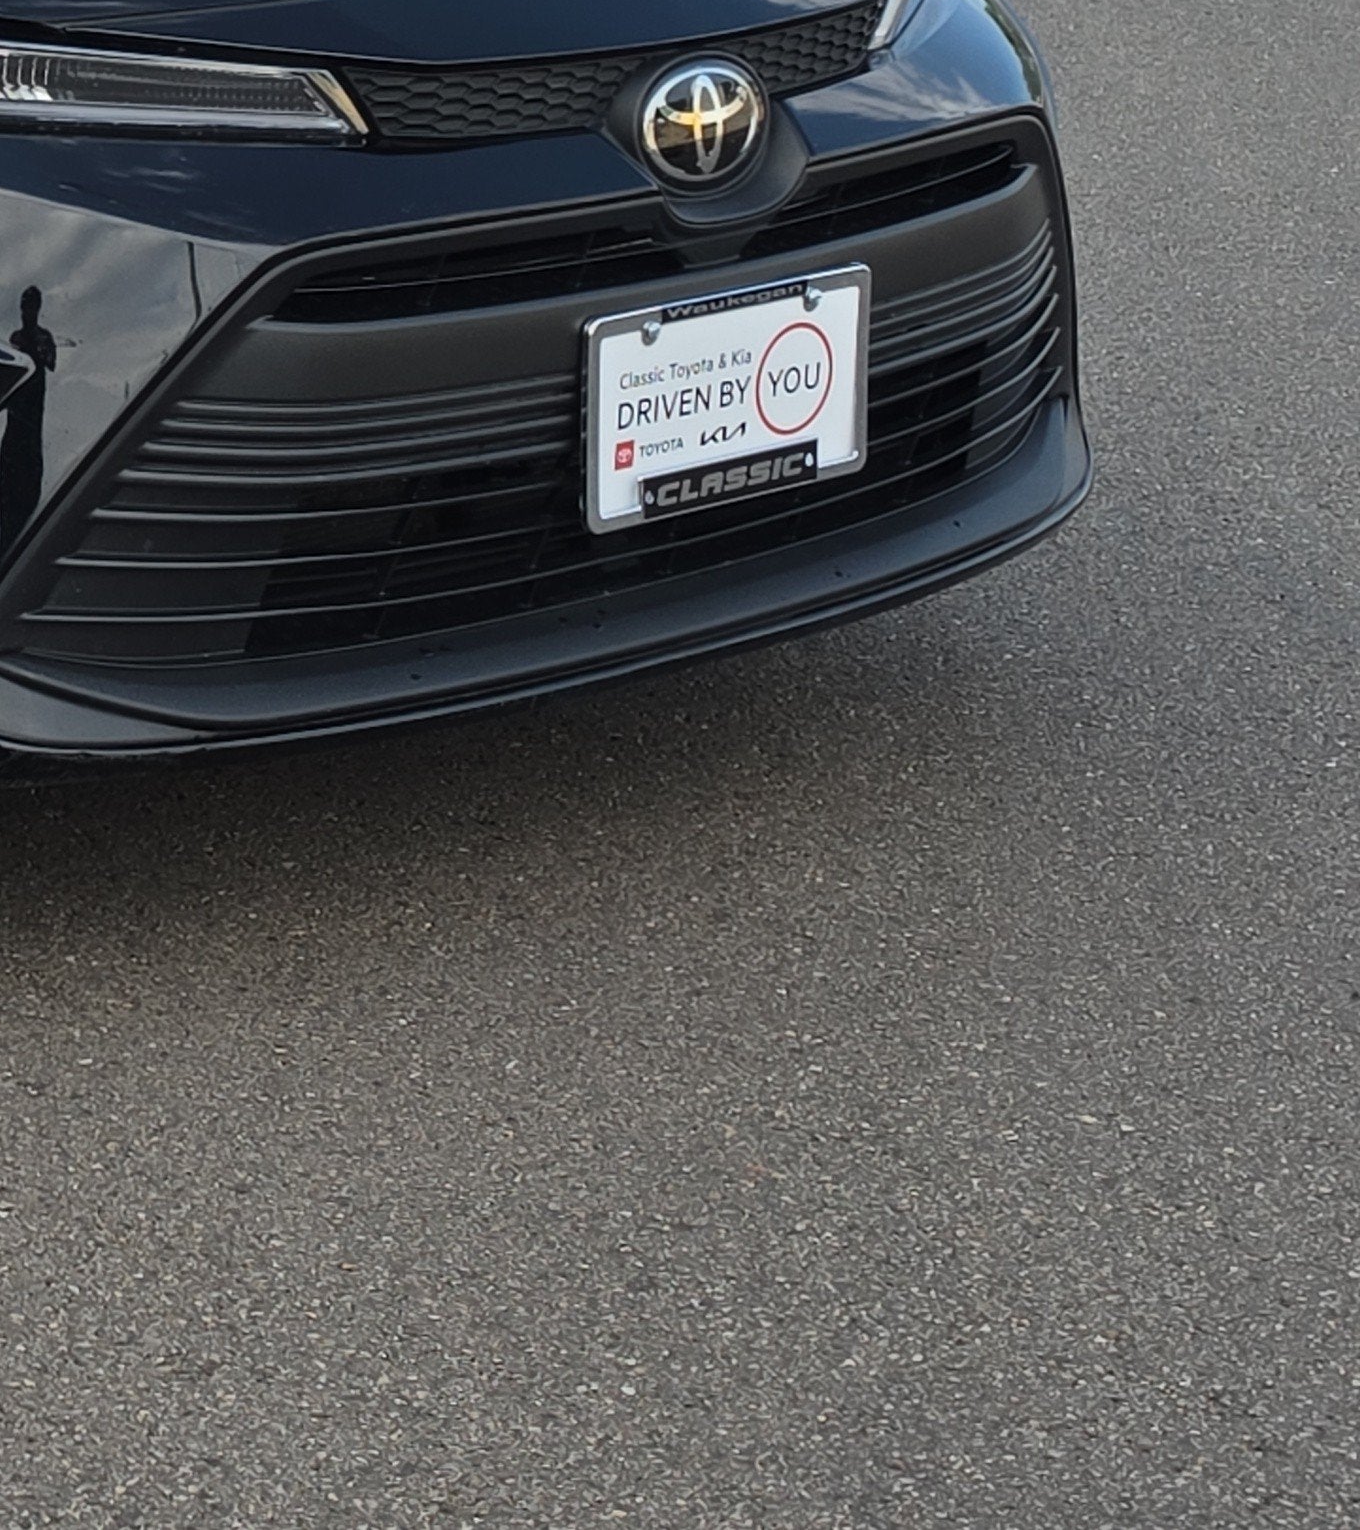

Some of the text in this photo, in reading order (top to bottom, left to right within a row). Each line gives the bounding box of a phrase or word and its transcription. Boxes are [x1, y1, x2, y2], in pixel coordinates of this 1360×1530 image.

[666, 283, 805, 319] Waukegan
[619, 348, 752, 390] Classic Toyota & Kia
[617, 361, 822, 430] DRIVEN BY YOU
[638, 437, 684, 458] TOYOTA
[655, 452, 805, 508] CLASSIC
